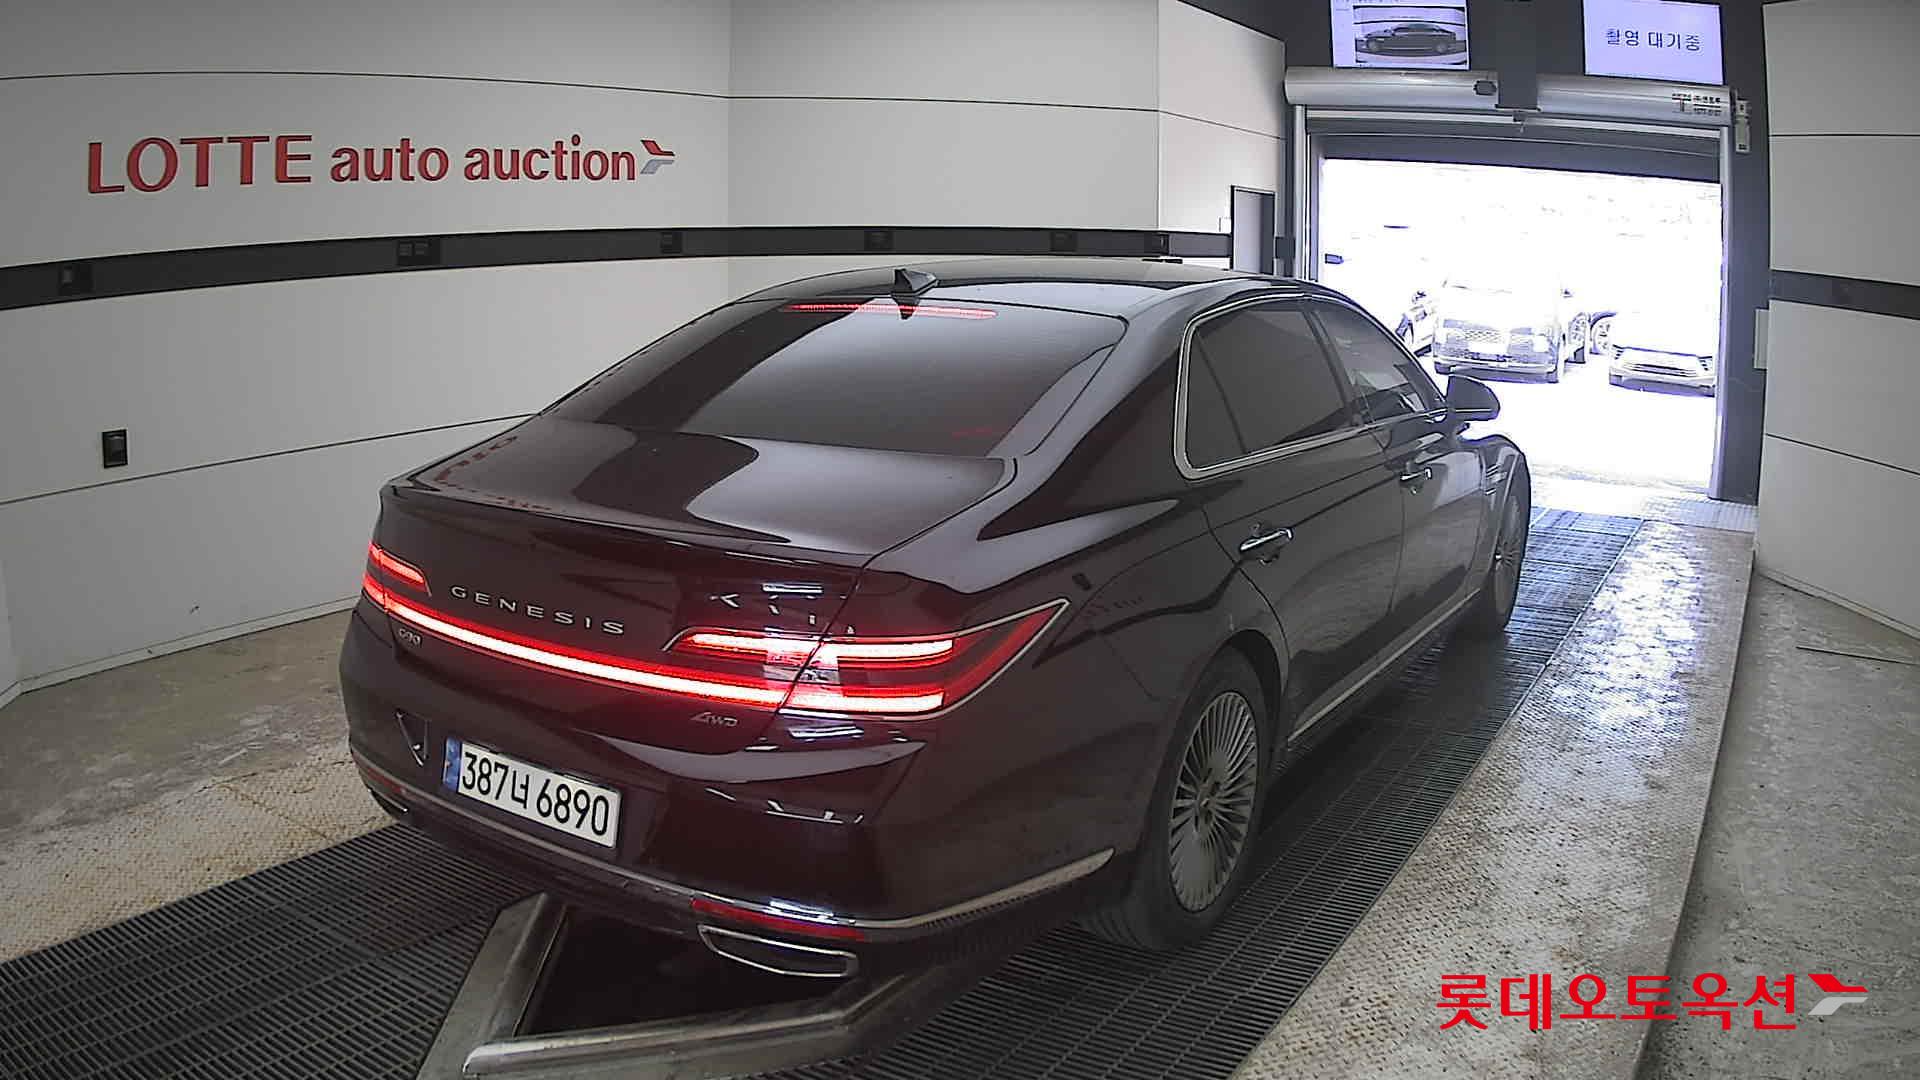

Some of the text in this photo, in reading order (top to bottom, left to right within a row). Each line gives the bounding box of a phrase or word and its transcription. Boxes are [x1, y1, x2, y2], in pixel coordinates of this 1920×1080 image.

[1647, 31, 1701, 52] 대기중
[87, 133, 637, 194] LOTTE auto auction
[450, 585, 626, 635] GENESIS
